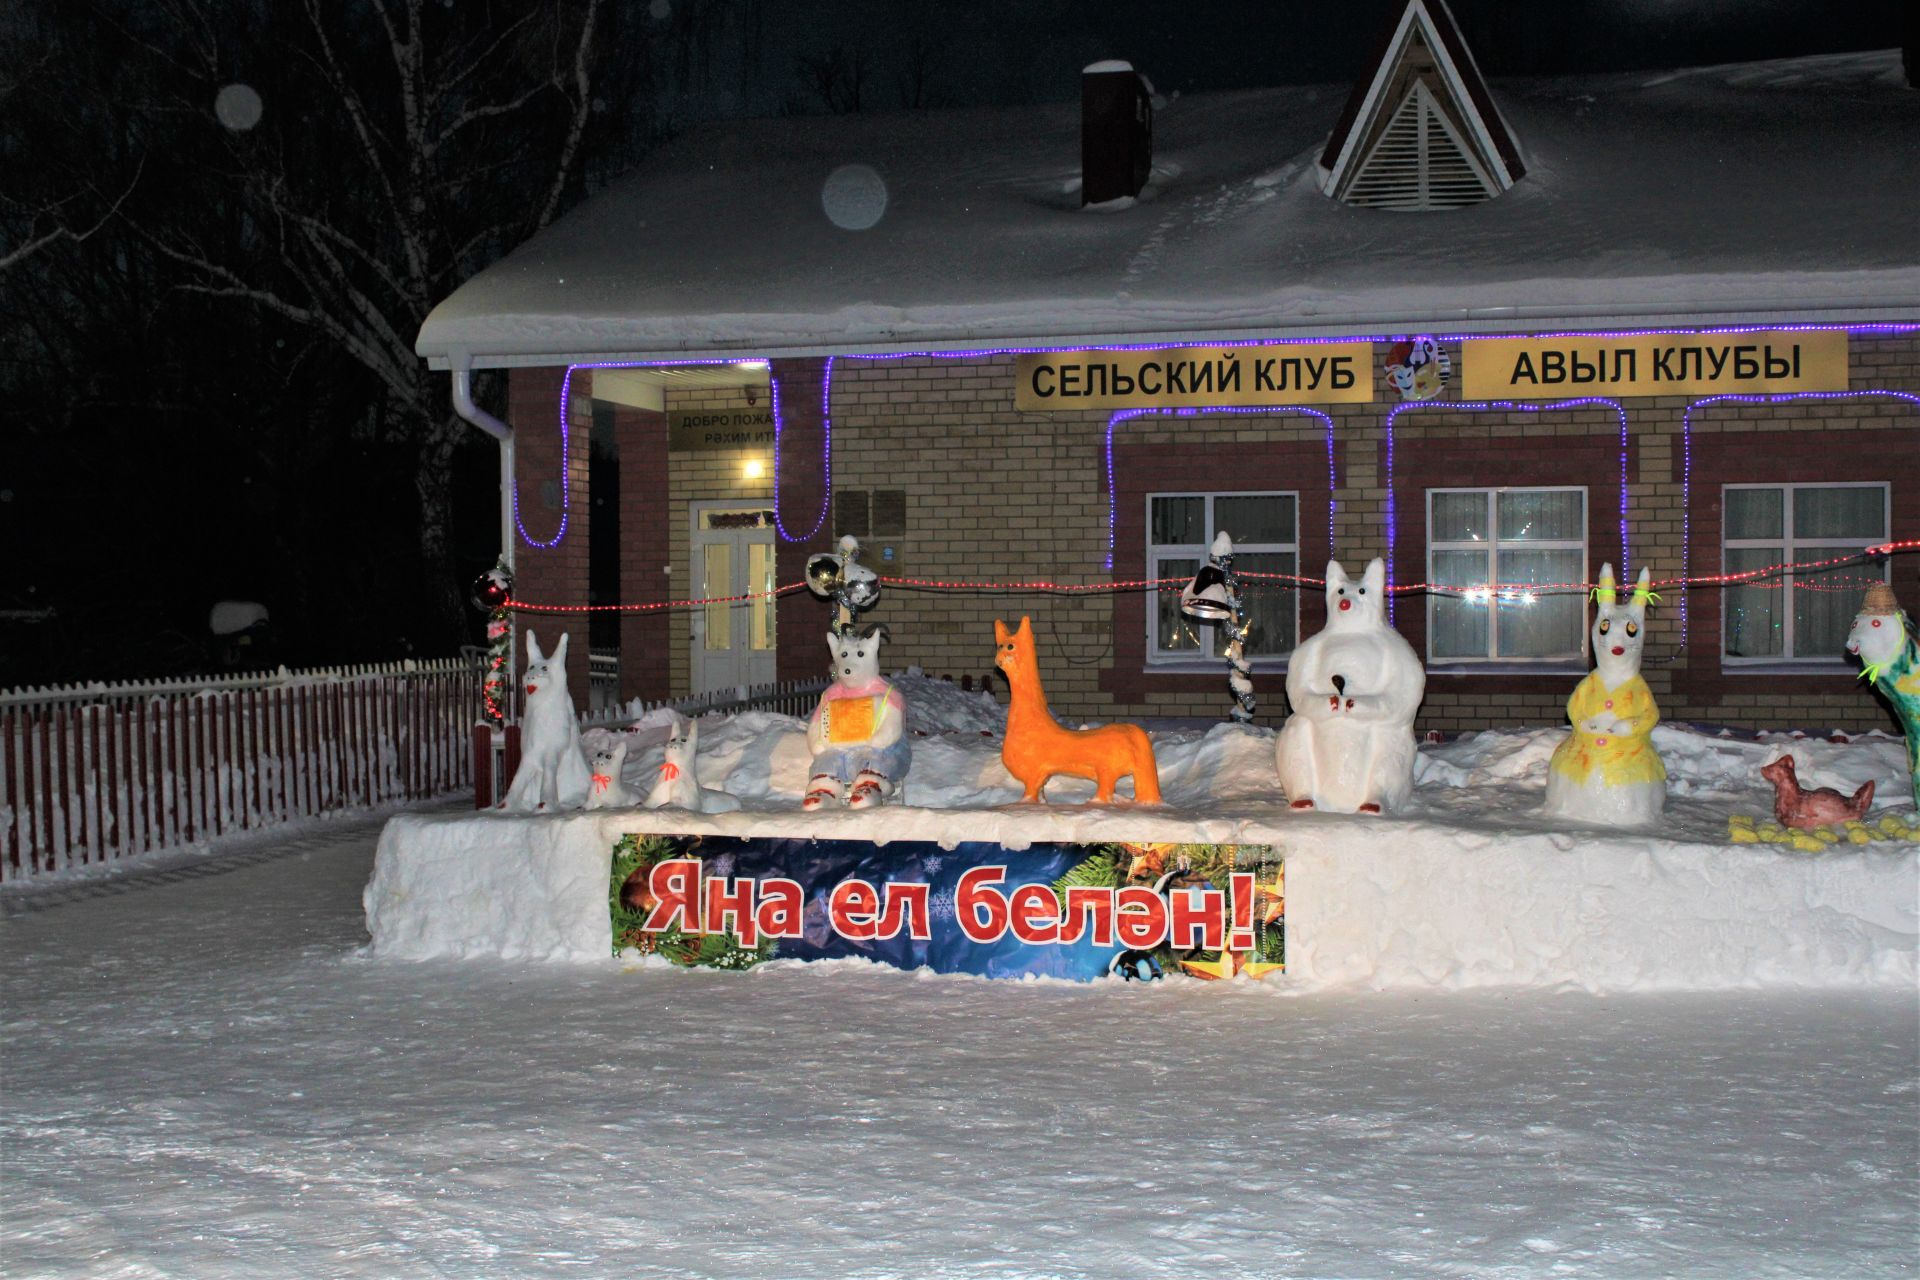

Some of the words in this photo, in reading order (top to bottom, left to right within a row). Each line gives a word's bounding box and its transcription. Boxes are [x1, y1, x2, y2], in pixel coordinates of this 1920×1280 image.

[1032, 353, 1241, 397] СЕЛЬСКИЙ
[1256, 356, 1355, 393] КЛУБ
[1510, 349, 1636, 384] АВЫЛ
[1653, 345, 1801, 382] КЛУБЫ
[682, 415, 729, 428] ДОБРО
[733, 414, 774, 426] ПОЖА
[755, 431, 775, 442] ИТ
[644, 859, 803, 949] Яңа
[831, 878, 931, 940] ел
[954, 865, 1256, 949] белән!
